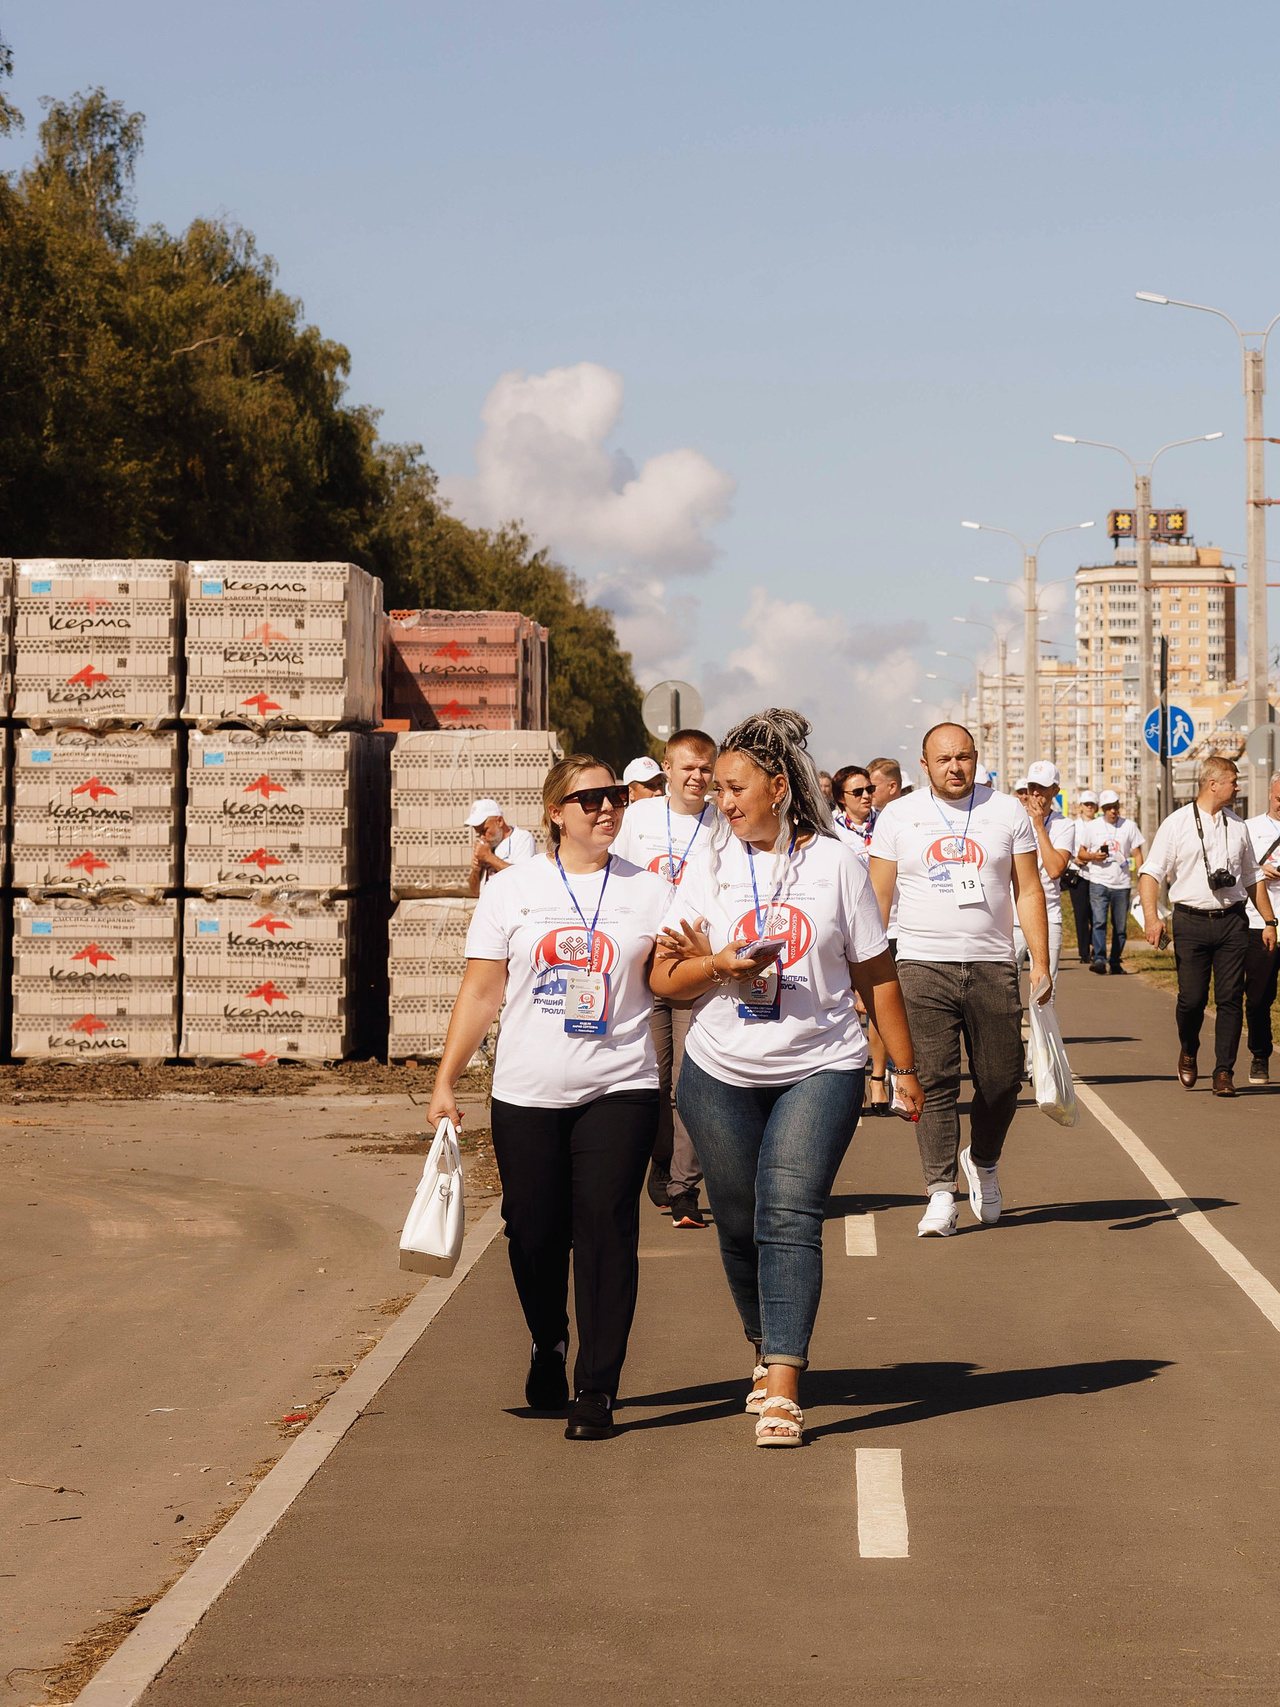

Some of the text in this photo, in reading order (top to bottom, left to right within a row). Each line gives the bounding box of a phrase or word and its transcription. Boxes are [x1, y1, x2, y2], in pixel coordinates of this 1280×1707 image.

[961, 879, 976, 890] 13
[790, 913, 799, 945] ЧЕБОКСАРЫ
[533, 998, 563, 1006] ЛУЧШИЙ
